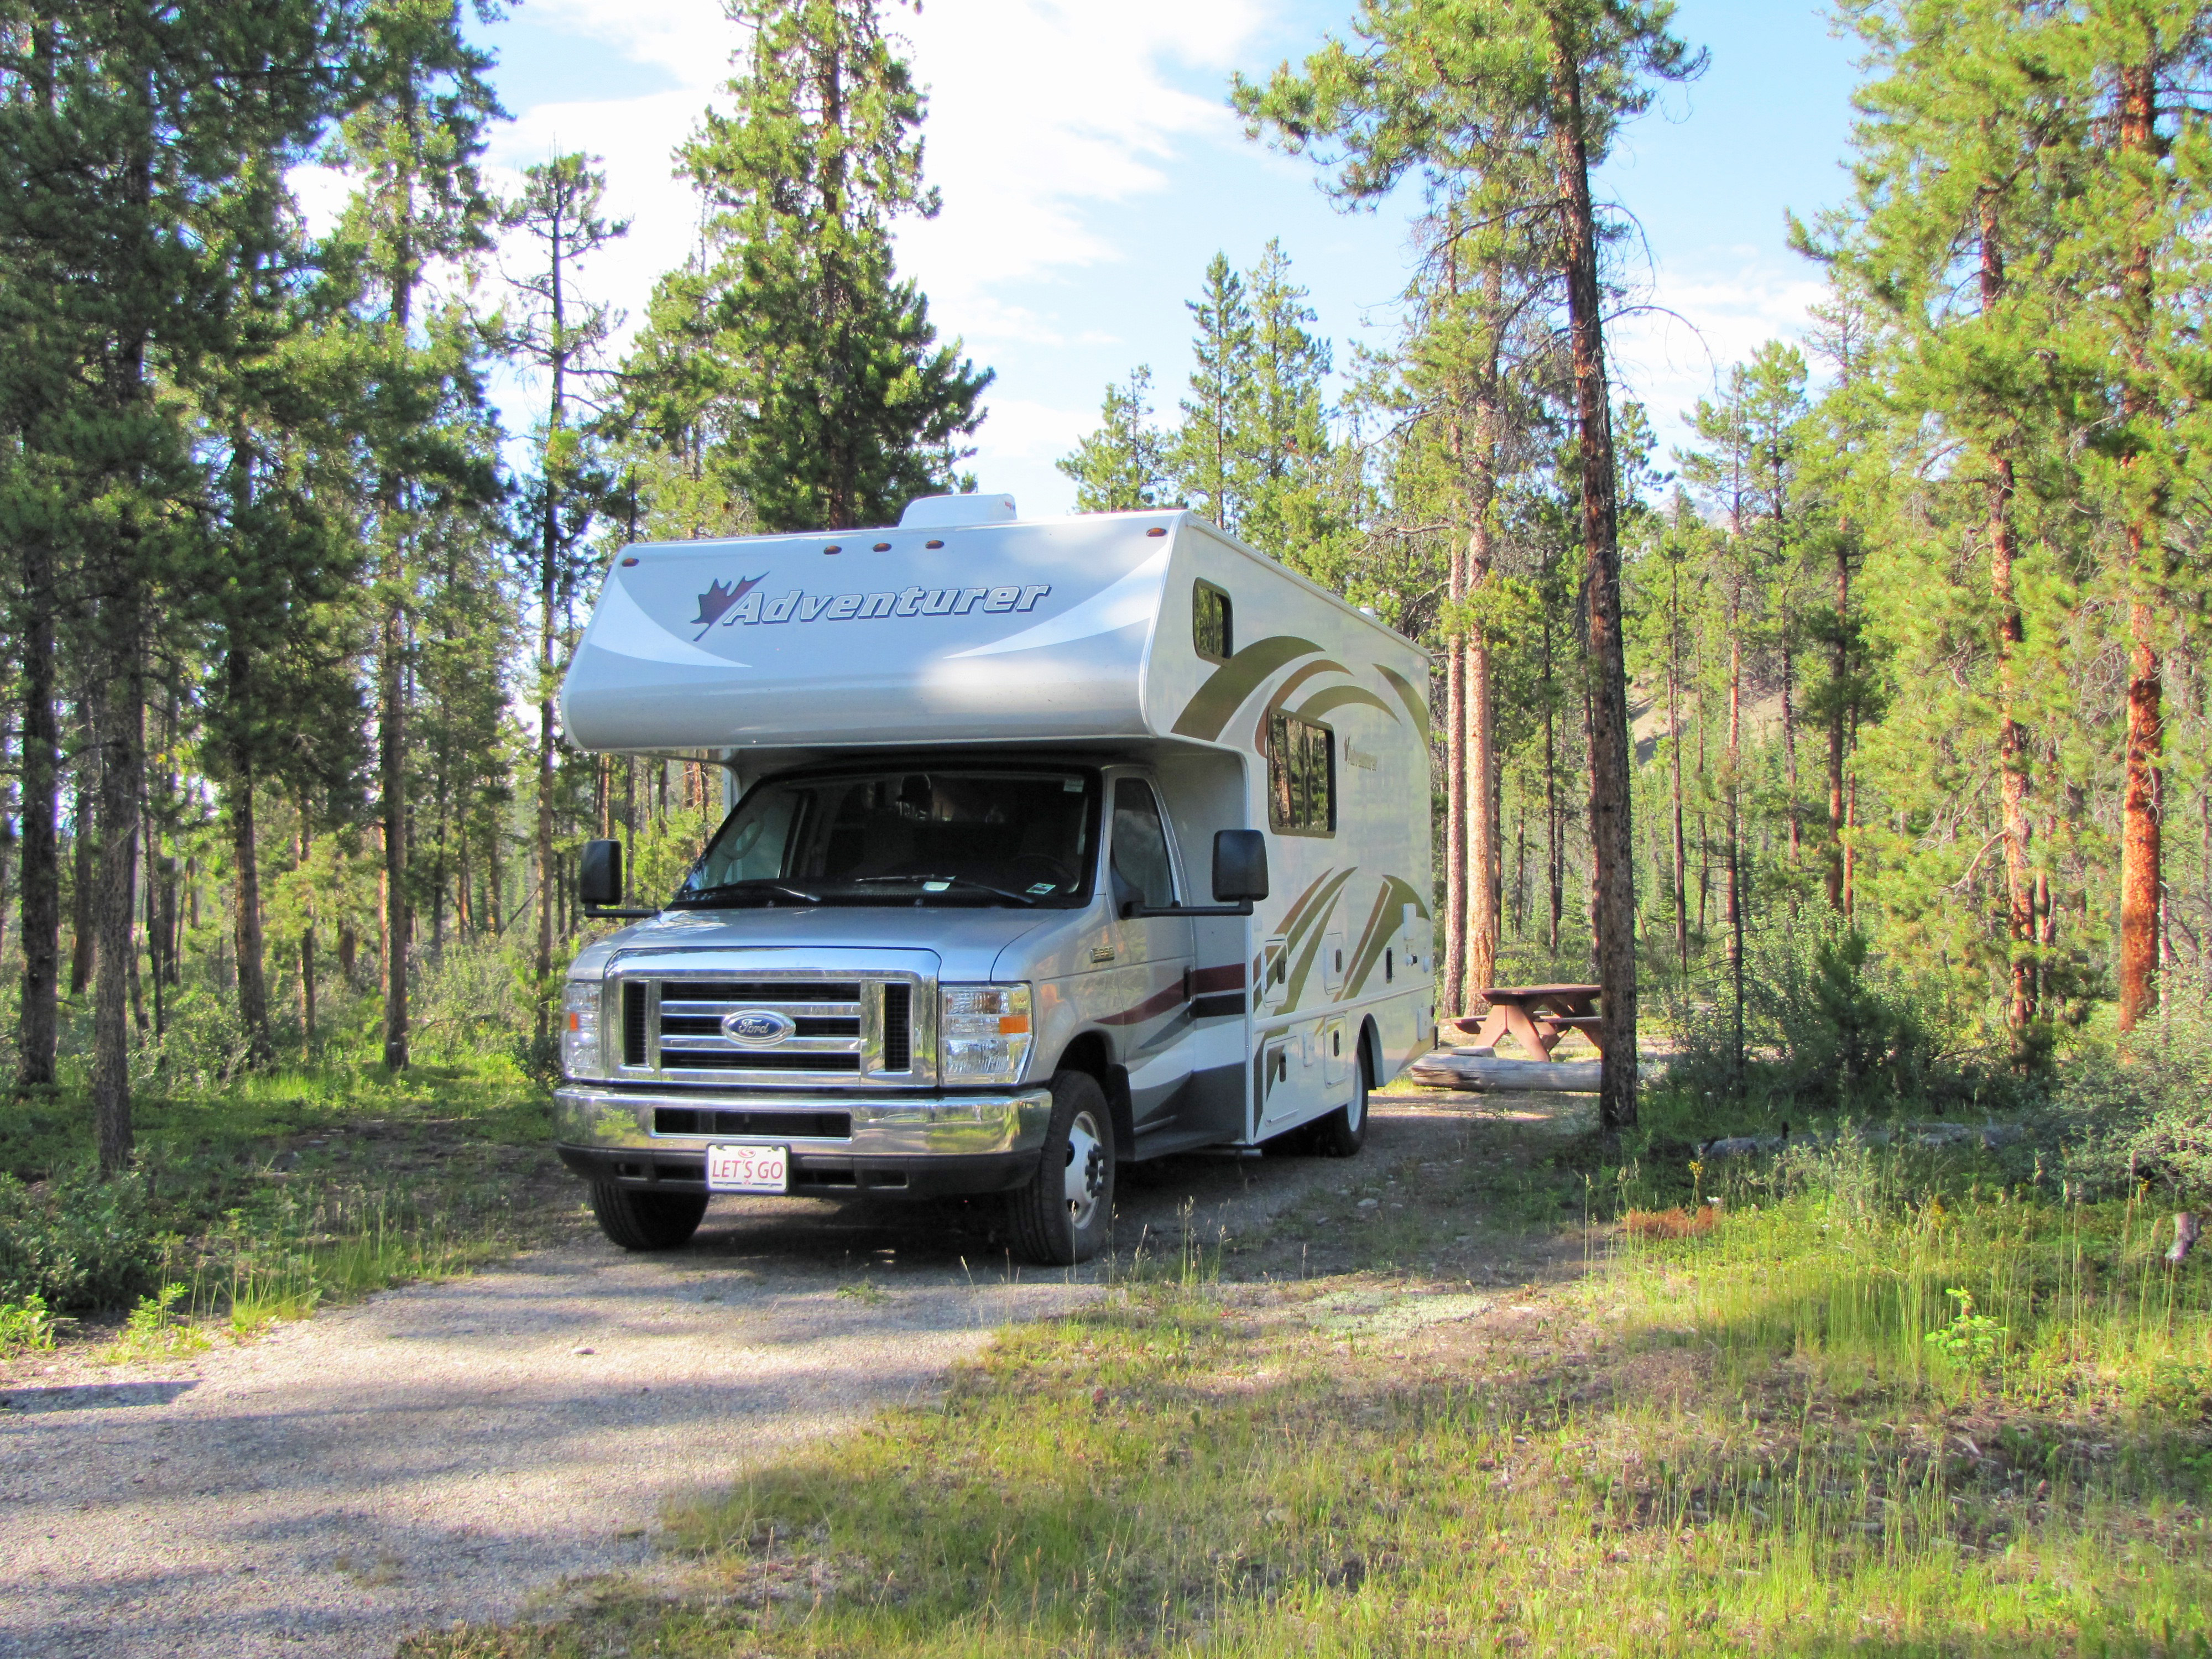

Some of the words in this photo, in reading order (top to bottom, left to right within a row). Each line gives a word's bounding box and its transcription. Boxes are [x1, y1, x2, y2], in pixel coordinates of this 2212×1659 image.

[722, 583, 1052, 627] Adventurer
[738, 1018, 770, 1034] Ford
[712, 1159, 753, 1178] LET'S
[758, 1161, 784, 1180] GO
